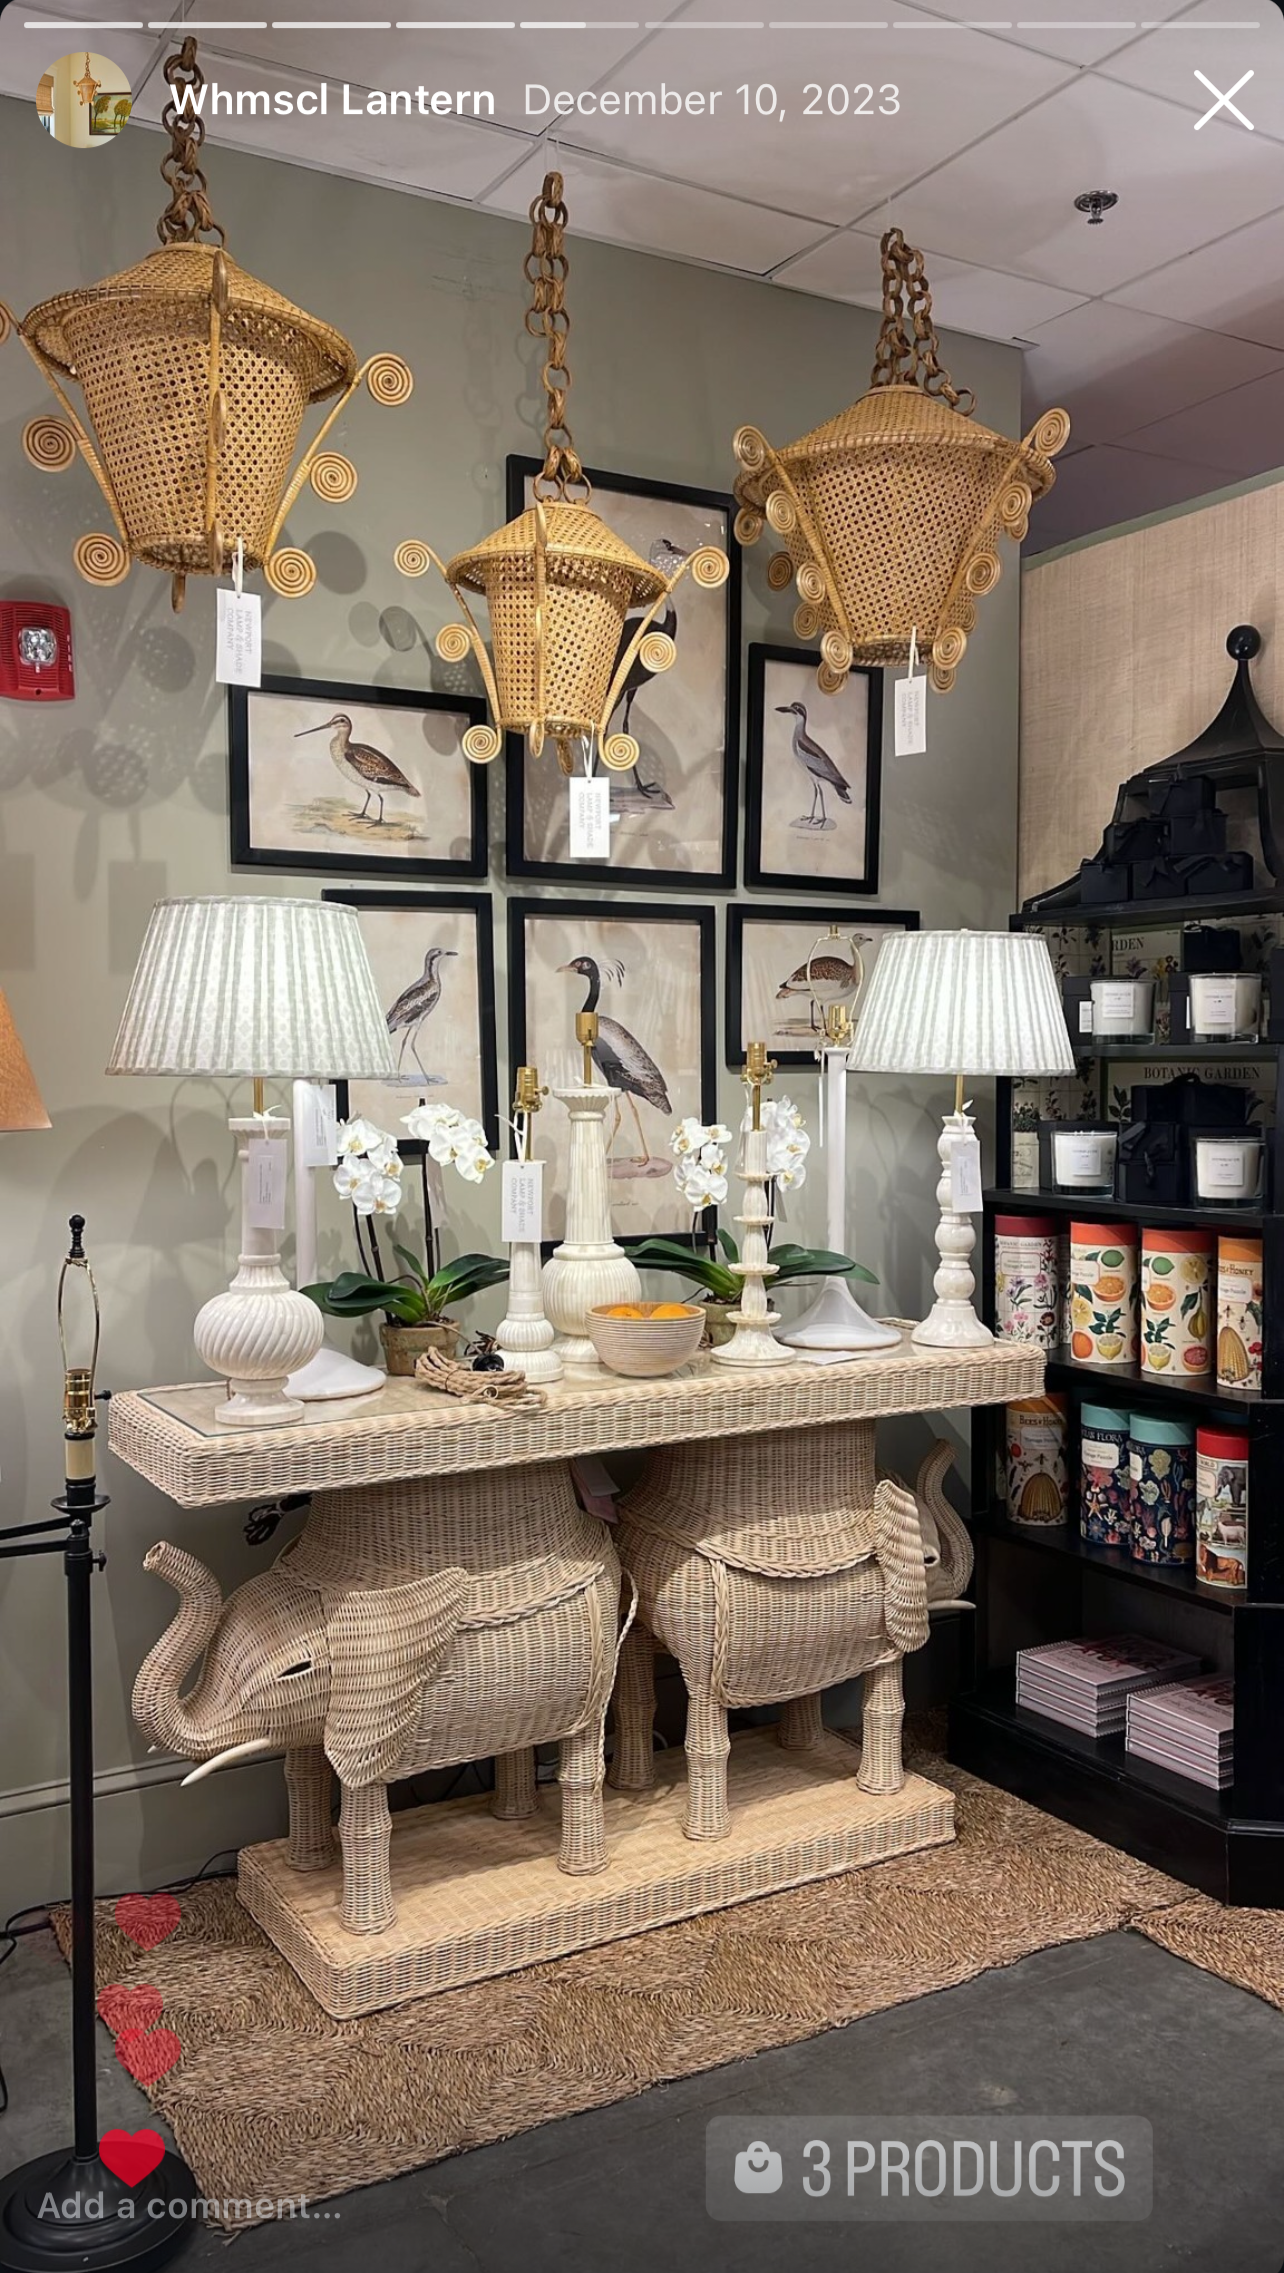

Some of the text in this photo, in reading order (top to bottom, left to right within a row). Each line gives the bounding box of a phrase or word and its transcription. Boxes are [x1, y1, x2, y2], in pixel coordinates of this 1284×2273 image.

[226, 607, 235, 651] COMPANY
[235, 609, 244, 632] LAMP
[244, 610, 253, 655] NEWPORT
[235, 643, 243, 674] SHADE
[1204, 1067, 1262, 1080] GARDEN
[510, 1177, 518, 1214] COMPANY
[526, 1178, 534, 1216] NEWPORT
[1096, 1431, 1123, 1443] FLORA
